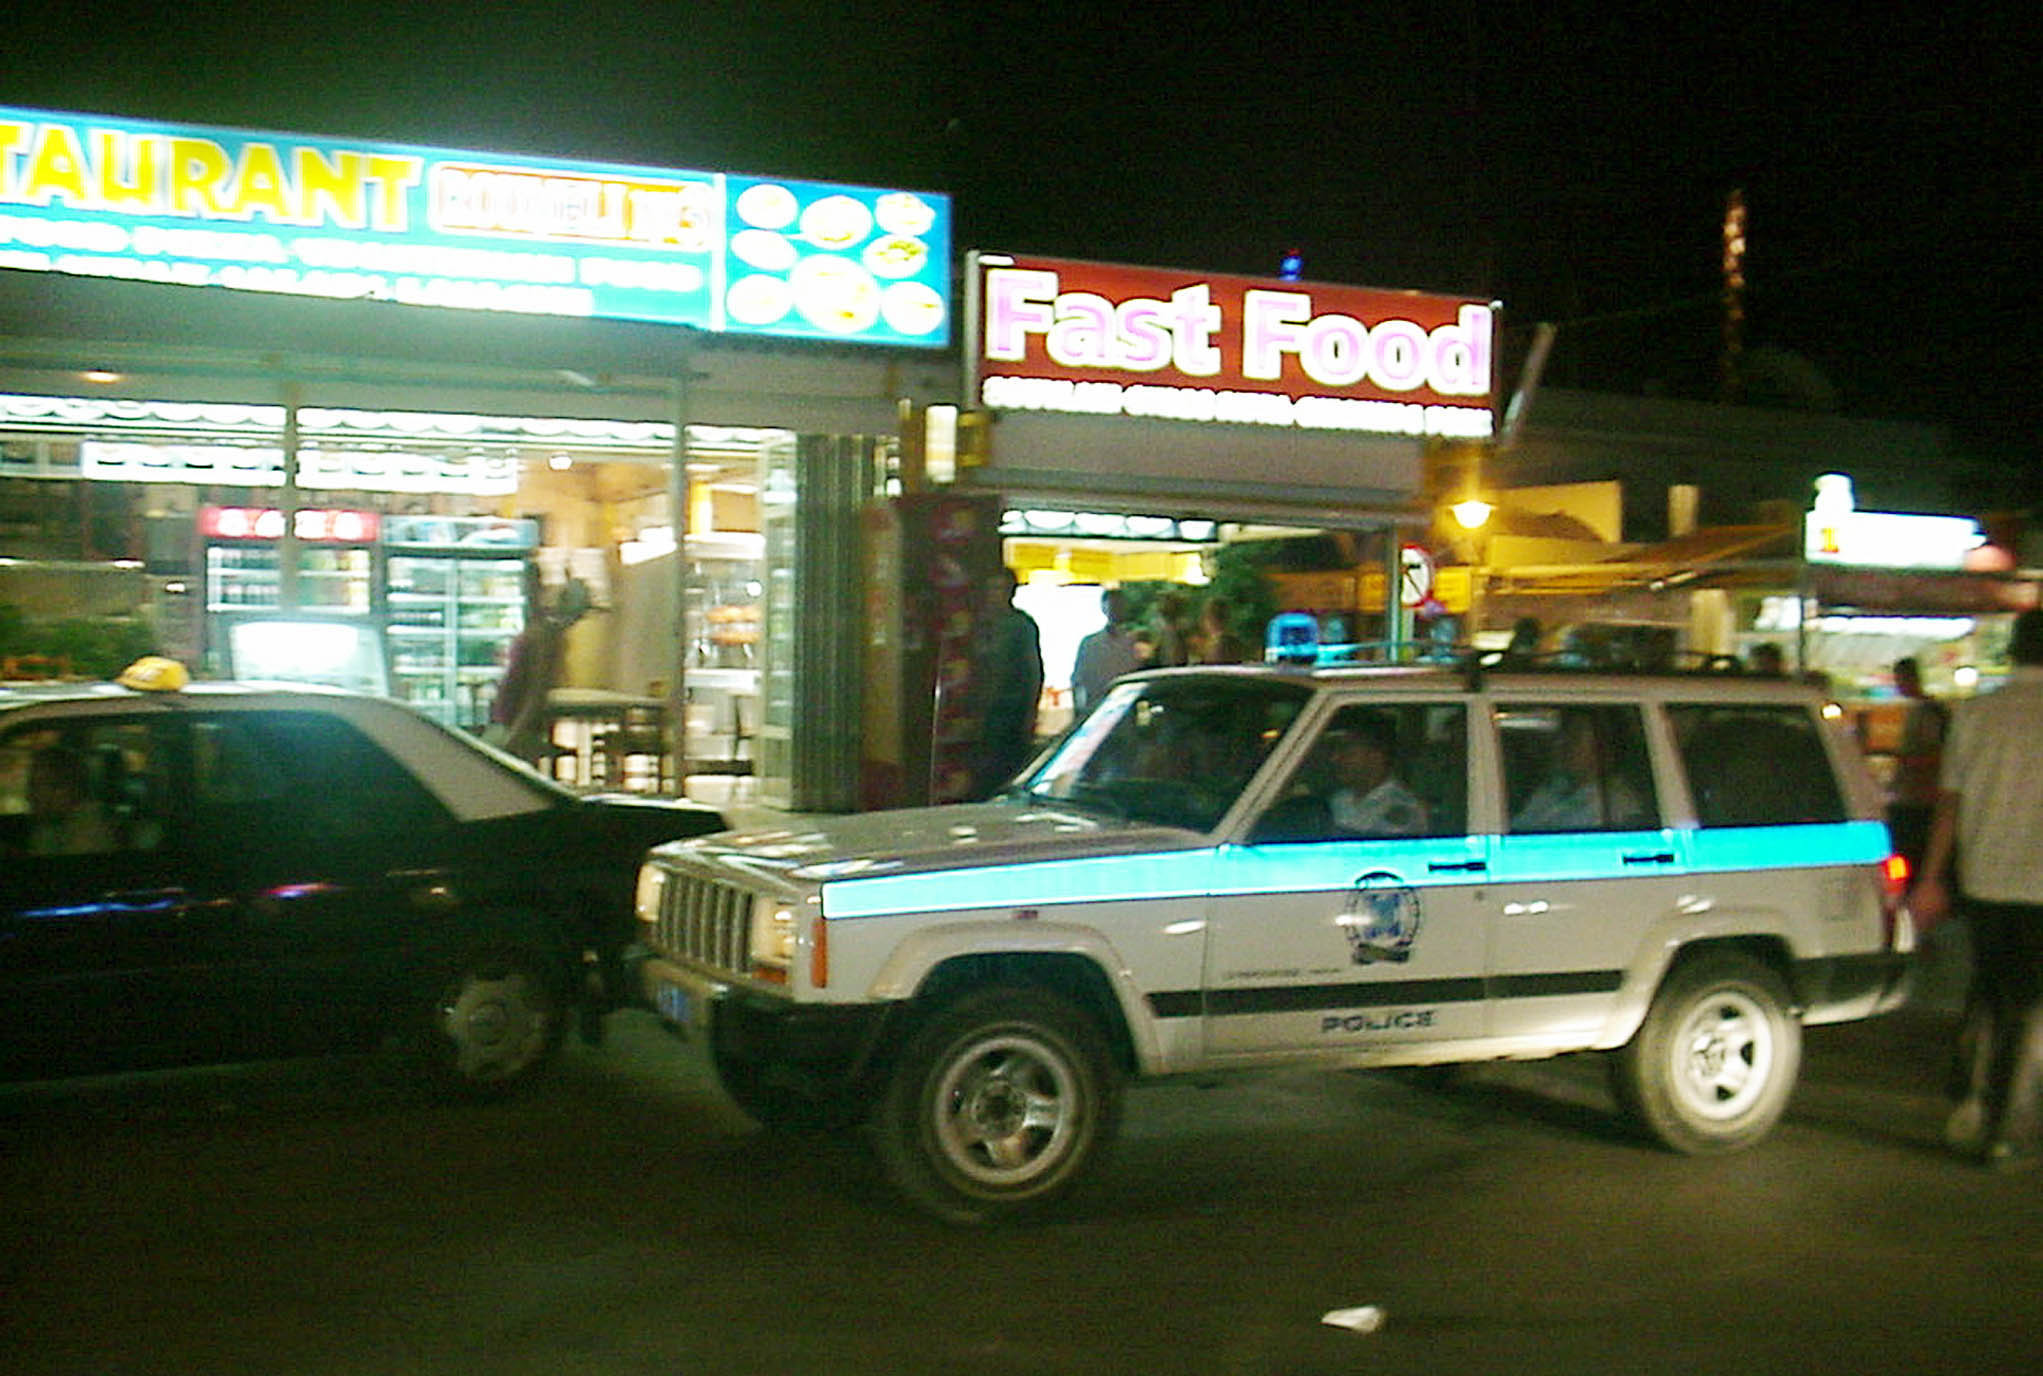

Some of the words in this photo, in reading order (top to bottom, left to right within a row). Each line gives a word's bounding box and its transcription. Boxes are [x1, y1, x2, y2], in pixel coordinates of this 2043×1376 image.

[986, 268, 1221, 376] Fast
[1243, 289, 1492, 396] Food
[1321, 1010, 1435, 1033] POLICE
